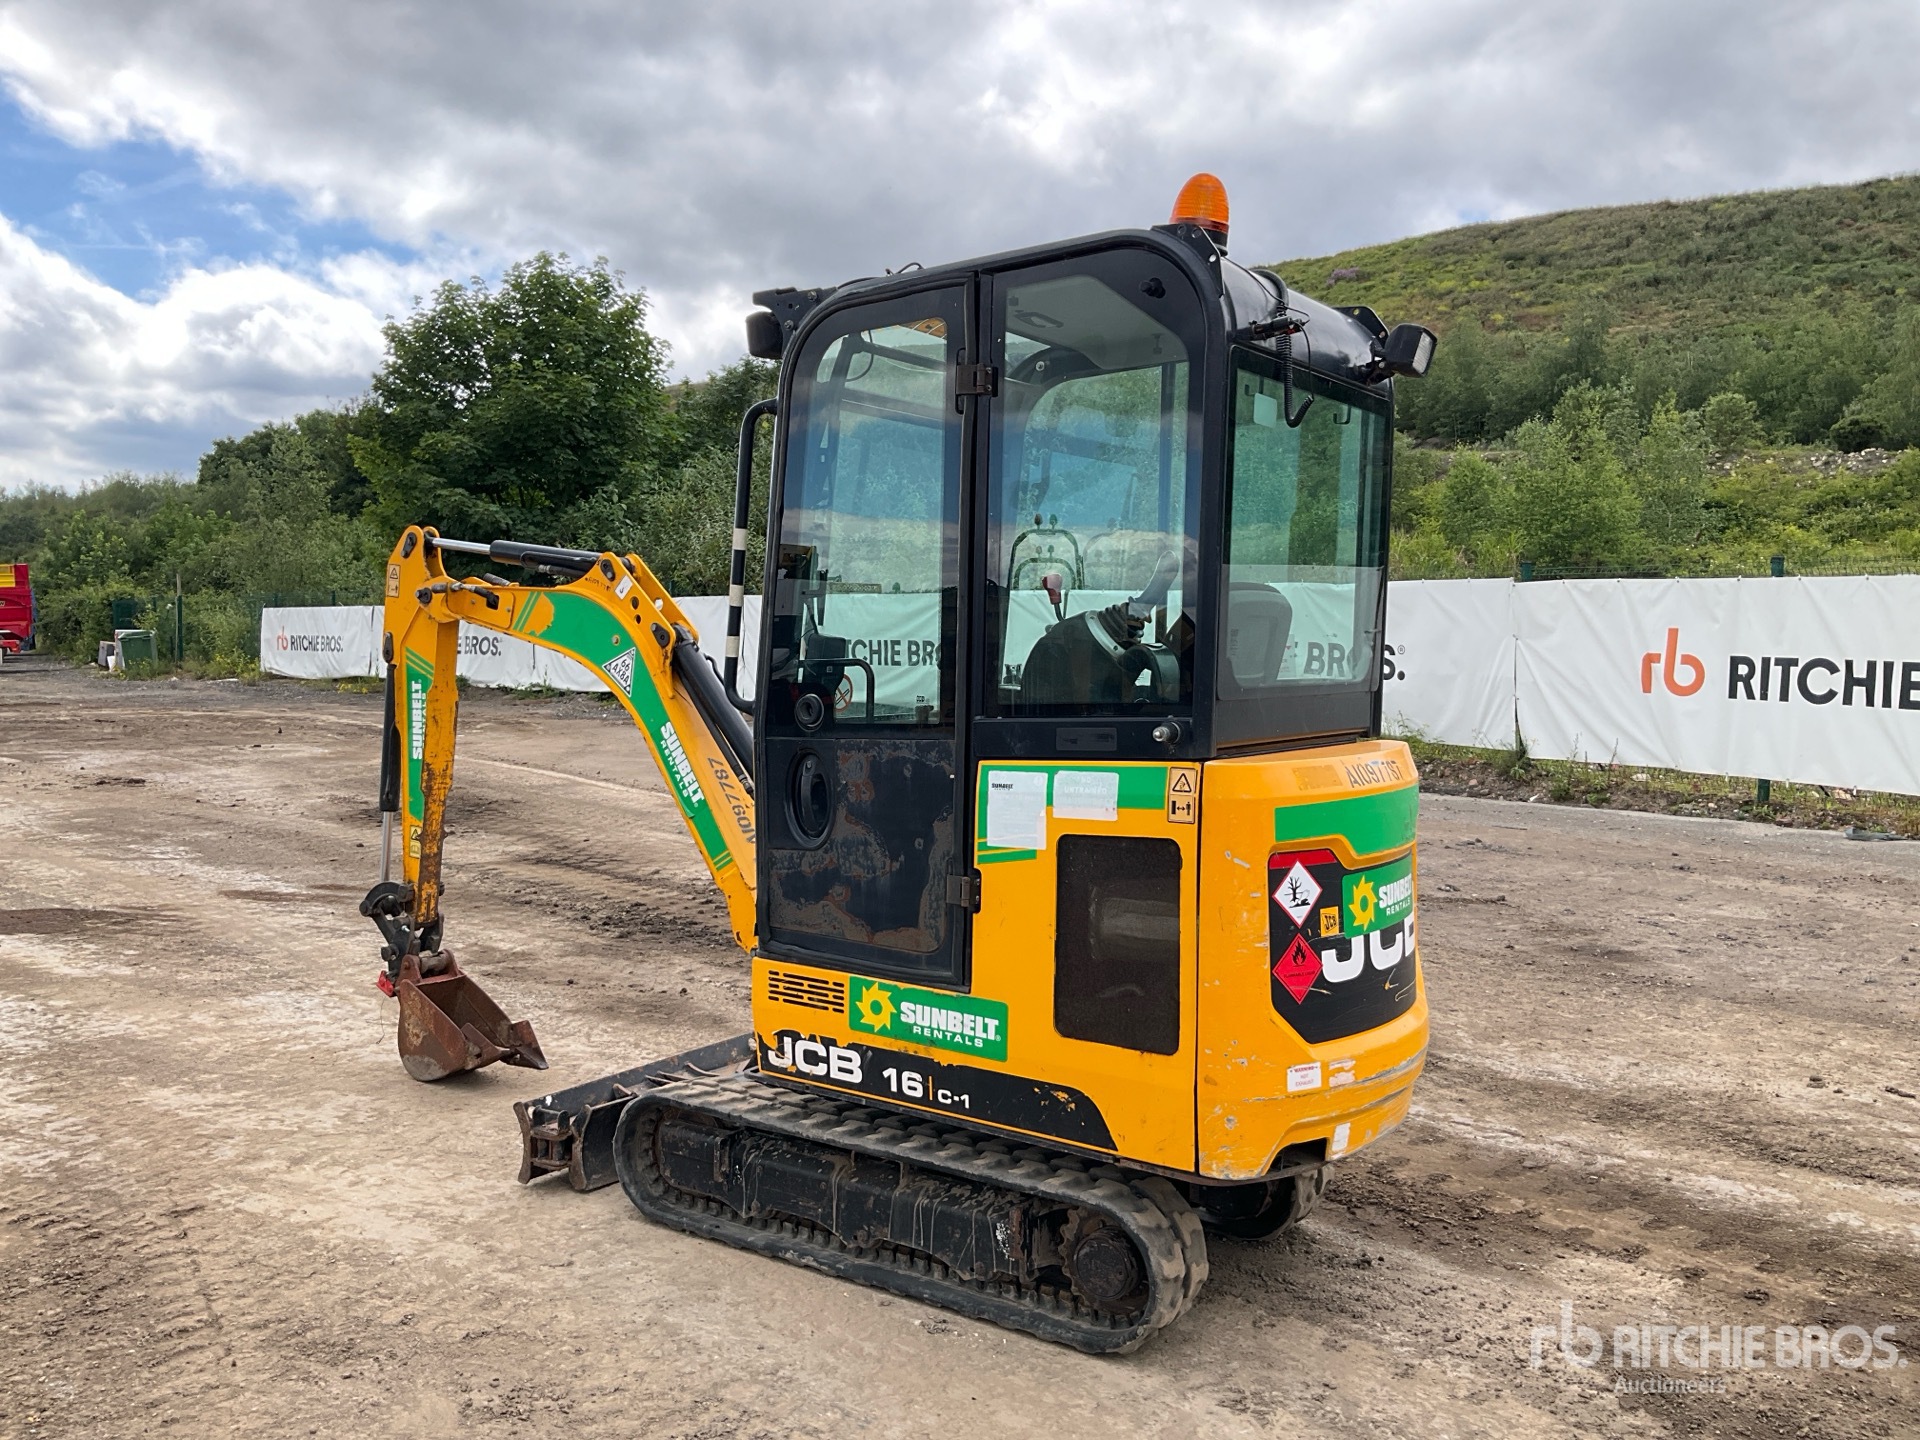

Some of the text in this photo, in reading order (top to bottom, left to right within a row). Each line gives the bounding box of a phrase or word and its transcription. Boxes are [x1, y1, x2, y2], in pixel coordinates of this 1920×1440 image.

[290, 635, 319, 651] RITCHIE
[321, 635, 343, 652] BROS.
[464, 635, 501, 656] BROS.
[621, 659, 630, 672] 66
[1641, 628, 1920, 711] rb RITCHIE
[411, 681, 423, 760] SUNBELT
[660, 721, 705, 804] SUNBELT
[660, 740, 689, 798] RENTALS
[1386, 897, 1411, 917] RENTALS
[1324, 914, 1337, 932] JCB
[900, 1001, 999, 1041] SUNBELT
[913, 1025, 984, 1048] RENTALS
[767, 1036, 863, 1083] JCB
[882, 1067, 924, 1098] 16
